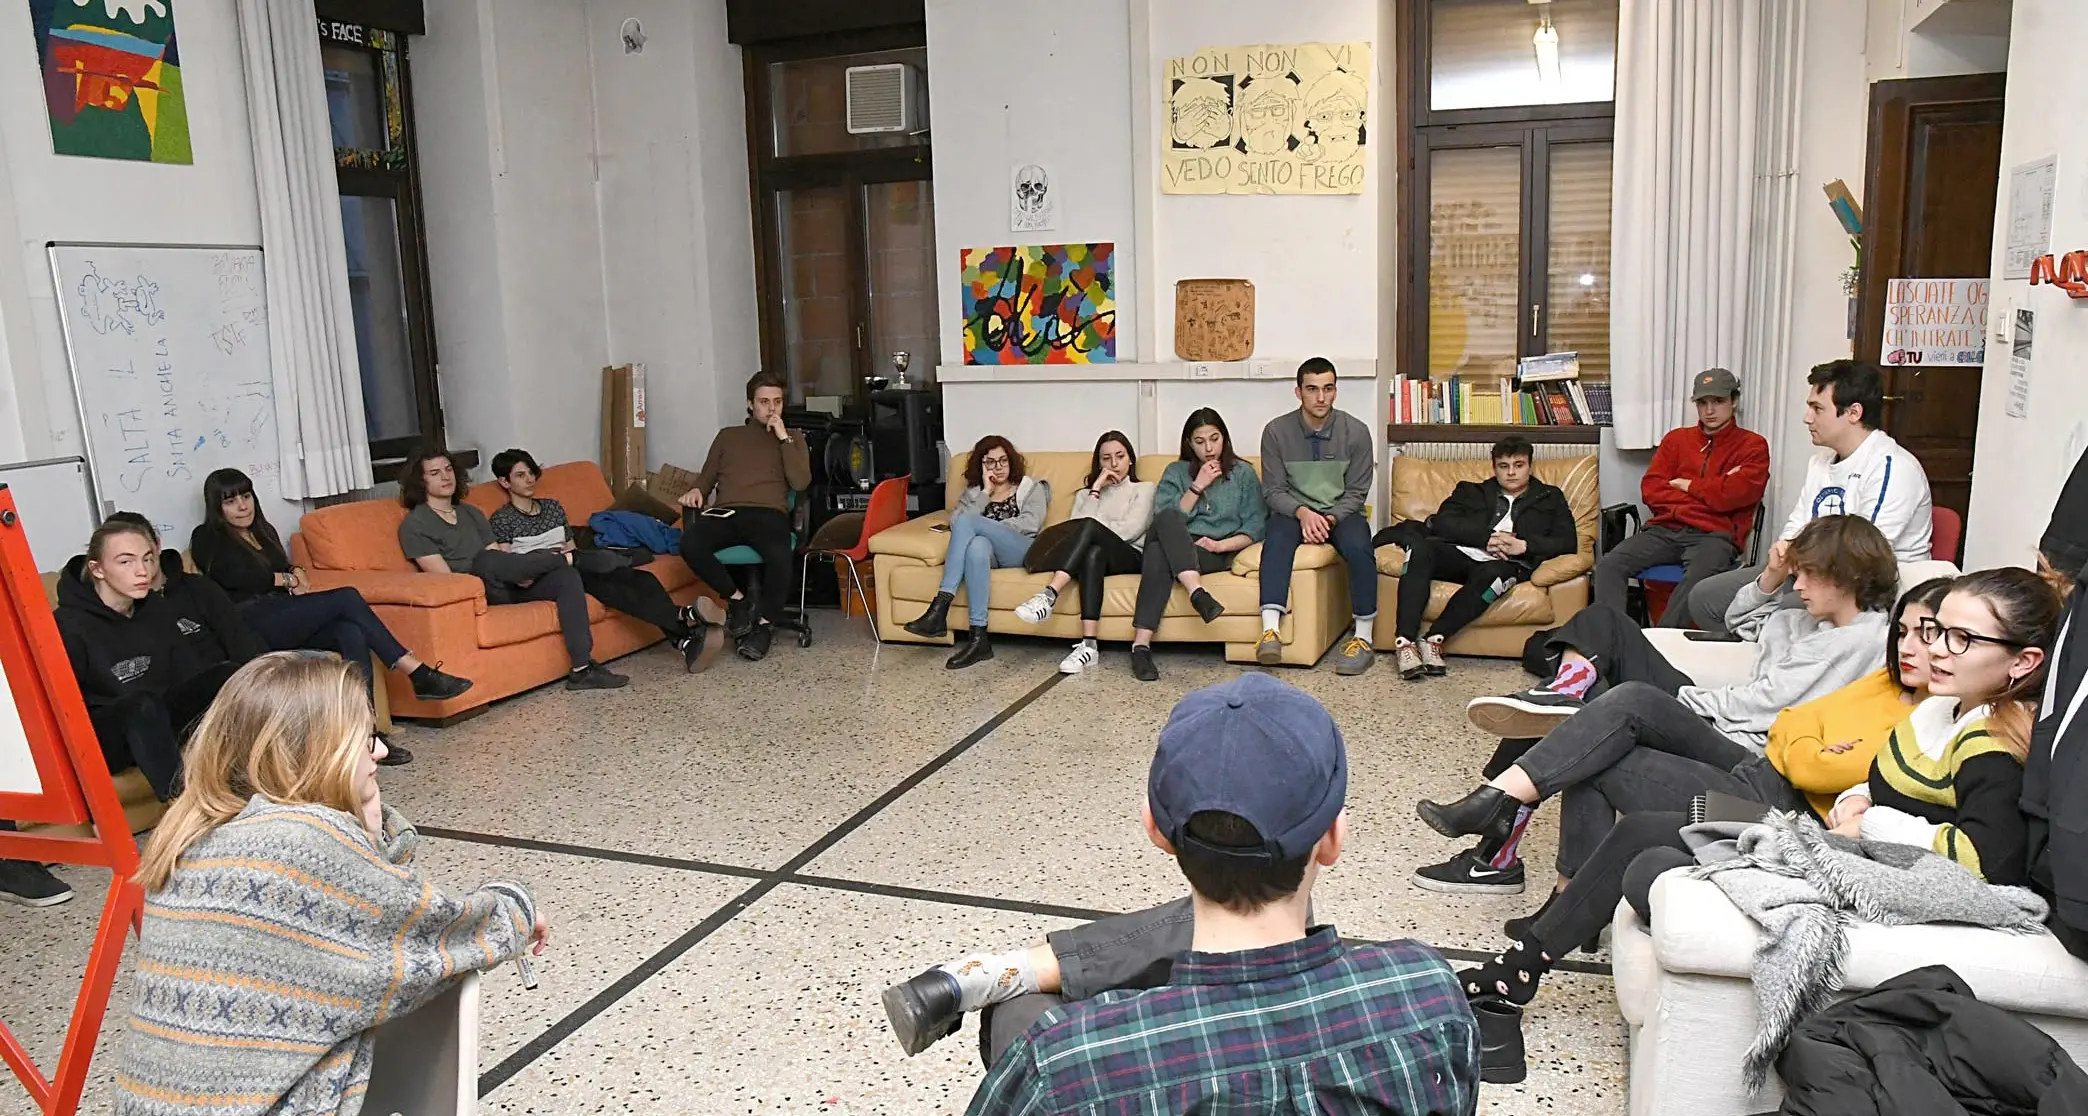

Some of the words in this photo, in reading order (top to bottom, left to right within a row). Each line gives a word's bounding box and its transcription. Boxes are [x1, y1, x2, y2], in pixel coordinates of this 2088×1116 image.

[331, 22, 363, 44] FACE
[1172, 53, 1229, 76] NON
[1247, 48, 1298, 72] NON
[1326, 45, 1352, 65] VI
[1165, 156, 1232, 187] VEDO
[1237, 159, 1293, 186] SENTO
[1299, 163, 1365, 190] FREGO
[1888, 281, 1958, 305] LASCIATE
[1906, 351, 1923, 364] TU
[1927, 350, 1947, 362] vieni
[1950, 353, 1955, 362] a
